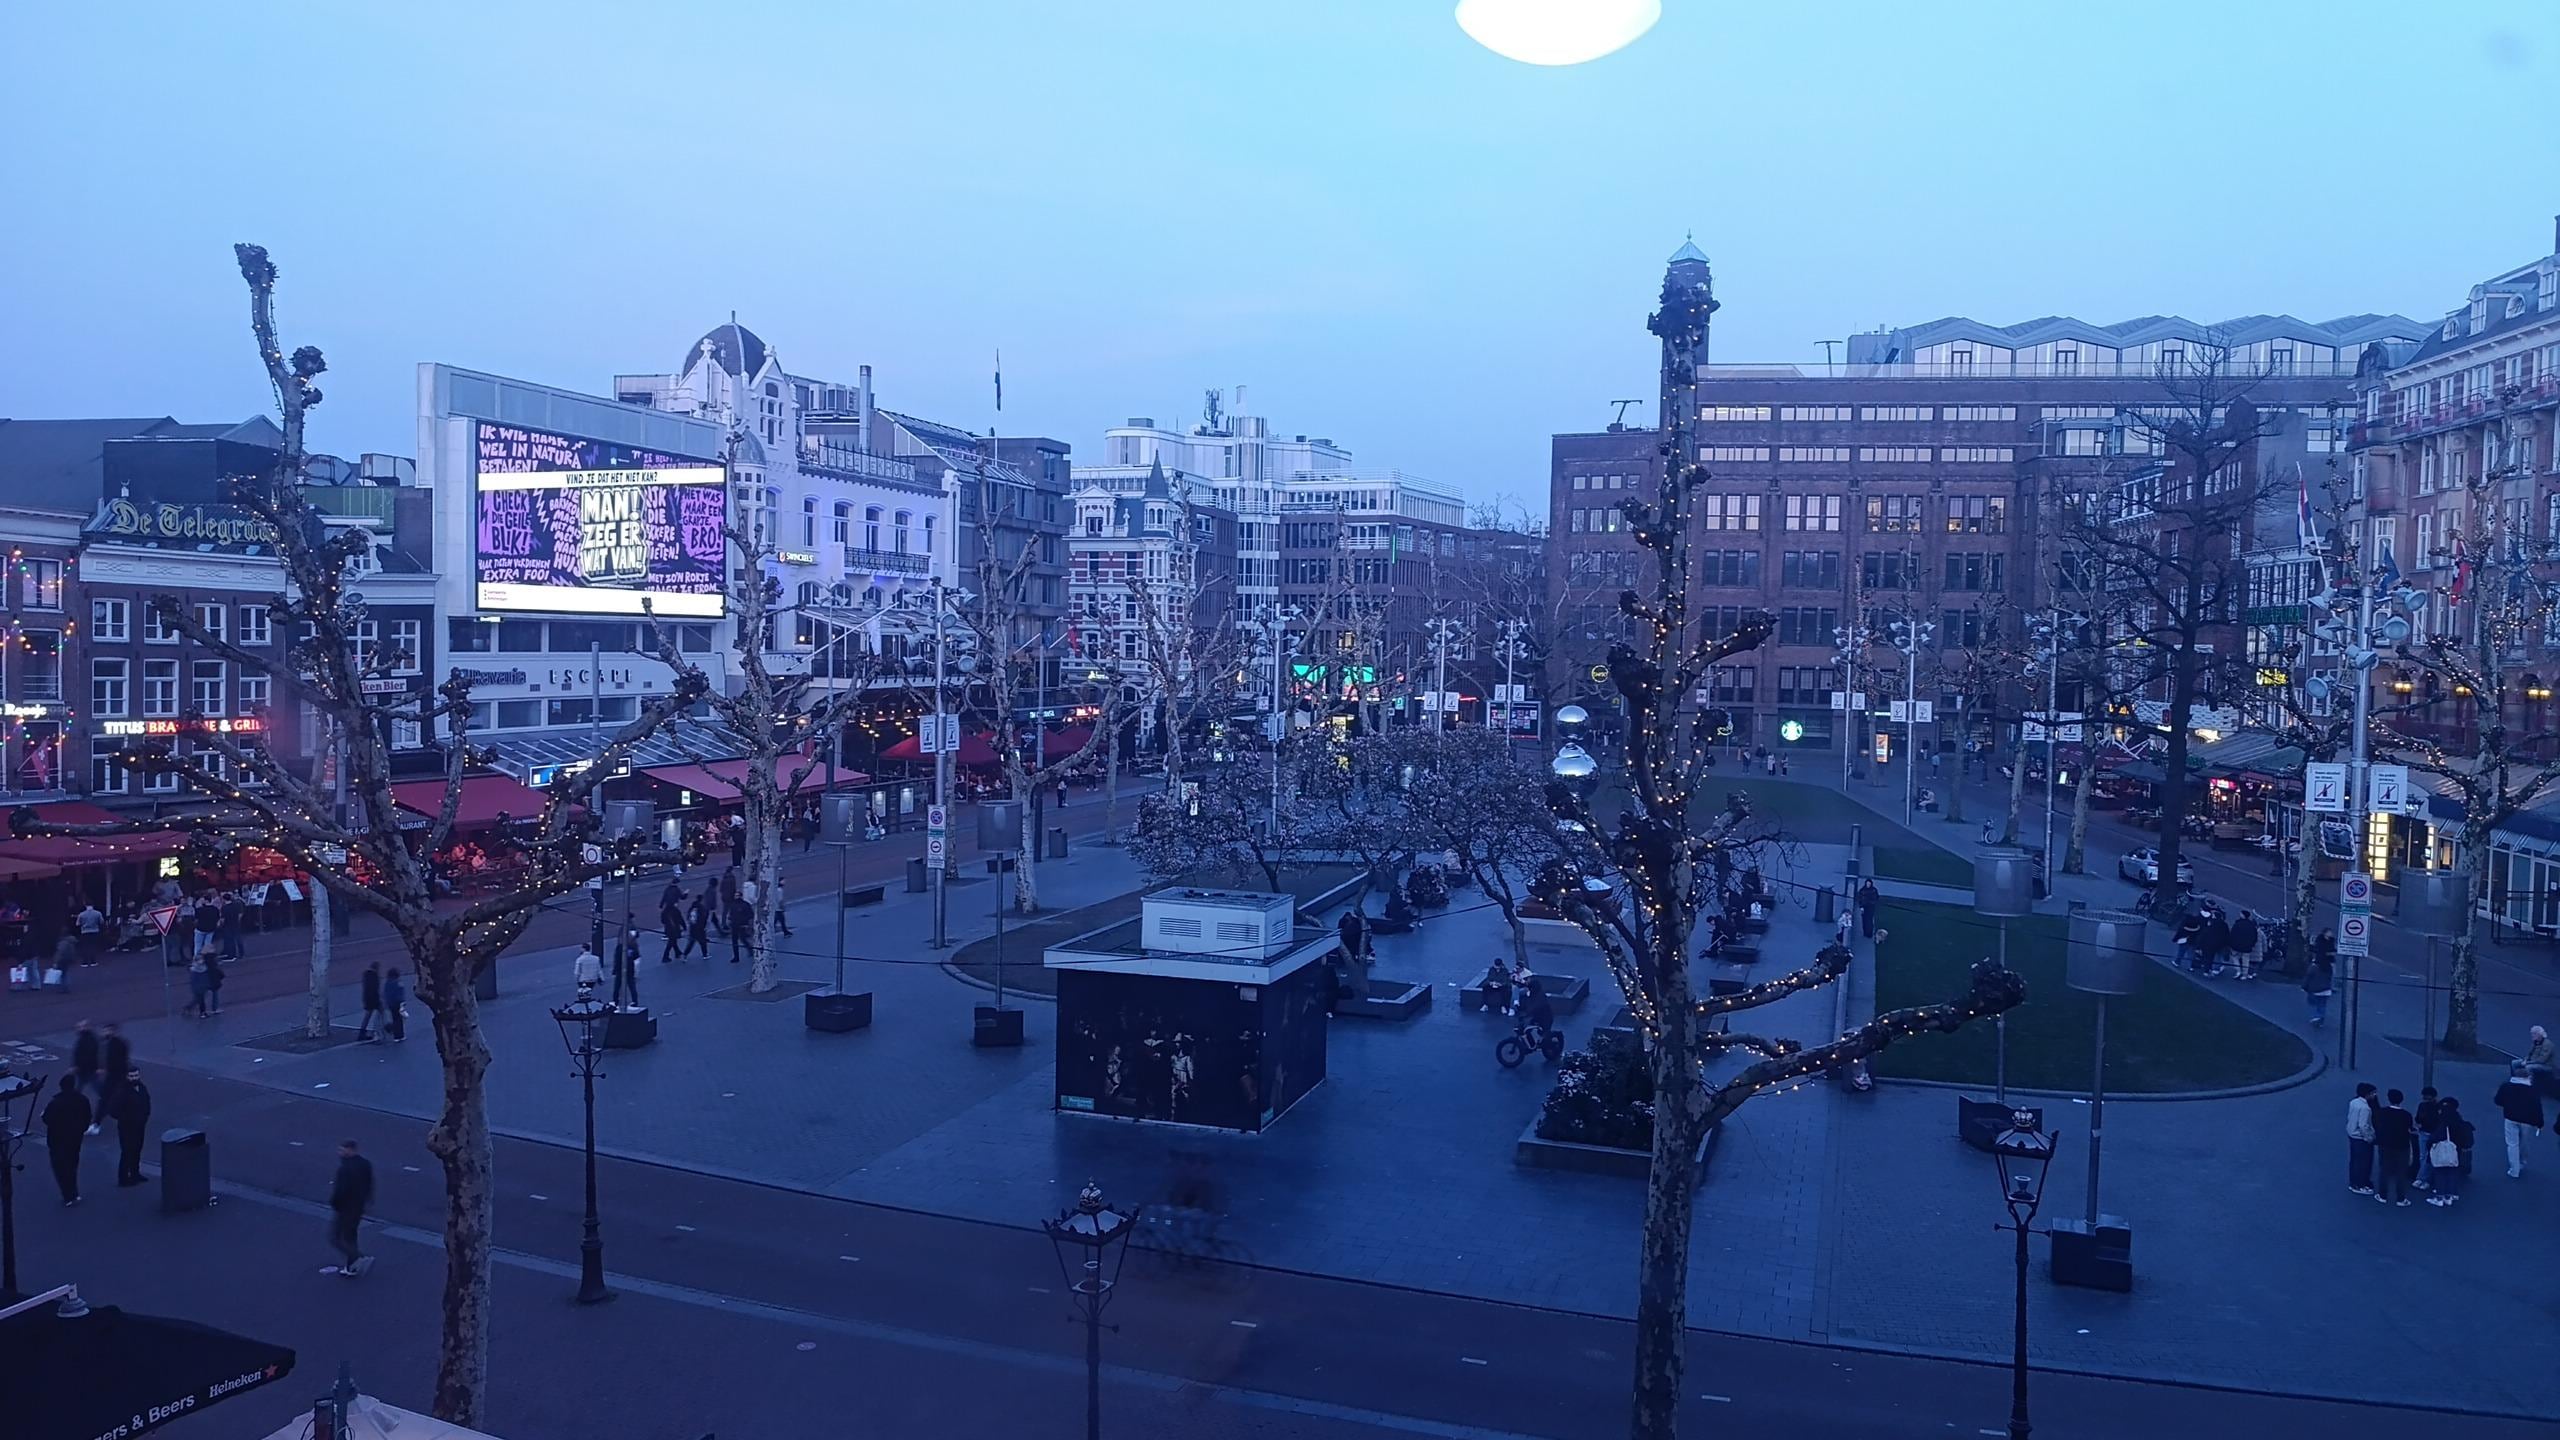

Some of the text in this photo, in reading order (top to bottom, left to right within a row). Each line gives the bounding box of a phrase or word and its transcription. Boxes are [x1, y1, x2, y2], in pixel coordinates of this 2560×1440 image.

[479, 424, 497, 440] IK
[499, 427, 528, 442] WIL
[479, 441, 582, 470] WEL IN NATURA
[479, 458, 539, 474] BETALEN!
[566, 471, 658, 485] VIND JE DAT HET NIET KAN?
[493, 489, 528, 512] CHECK
[560, 487, 581, 504] DIE
[684, 489, 721, 504] HET WAS
[584, 489, 640, 522] MAN!
[683, 500, 707, 515] MAAR
[109, 499, 272, 546] De Telegraa
[492, 510, 503, 524] DIE
[553, 509, 576, 525] MAG
[647, 508, 667, 524] DIE
[550, 521, 568, 532] MET
[492, 526, 529, 555] BLIK!
[583, 521, 641, 549] ZEG ER
[690, 520, 722, 550] BRO!
[583, 545, 643, 571] WAT VAN!
[483, 568, 520, 581] EXTRA
[383, 680, 406, 692] Bier
[103, 720, 145, 735] TITUS
[219, 719, 231, 732] &
[131, 1413, 144, 1431] &
[148, 1394, 195, 1424] Beers
[208, 1369, 262, 1398] Heineken
